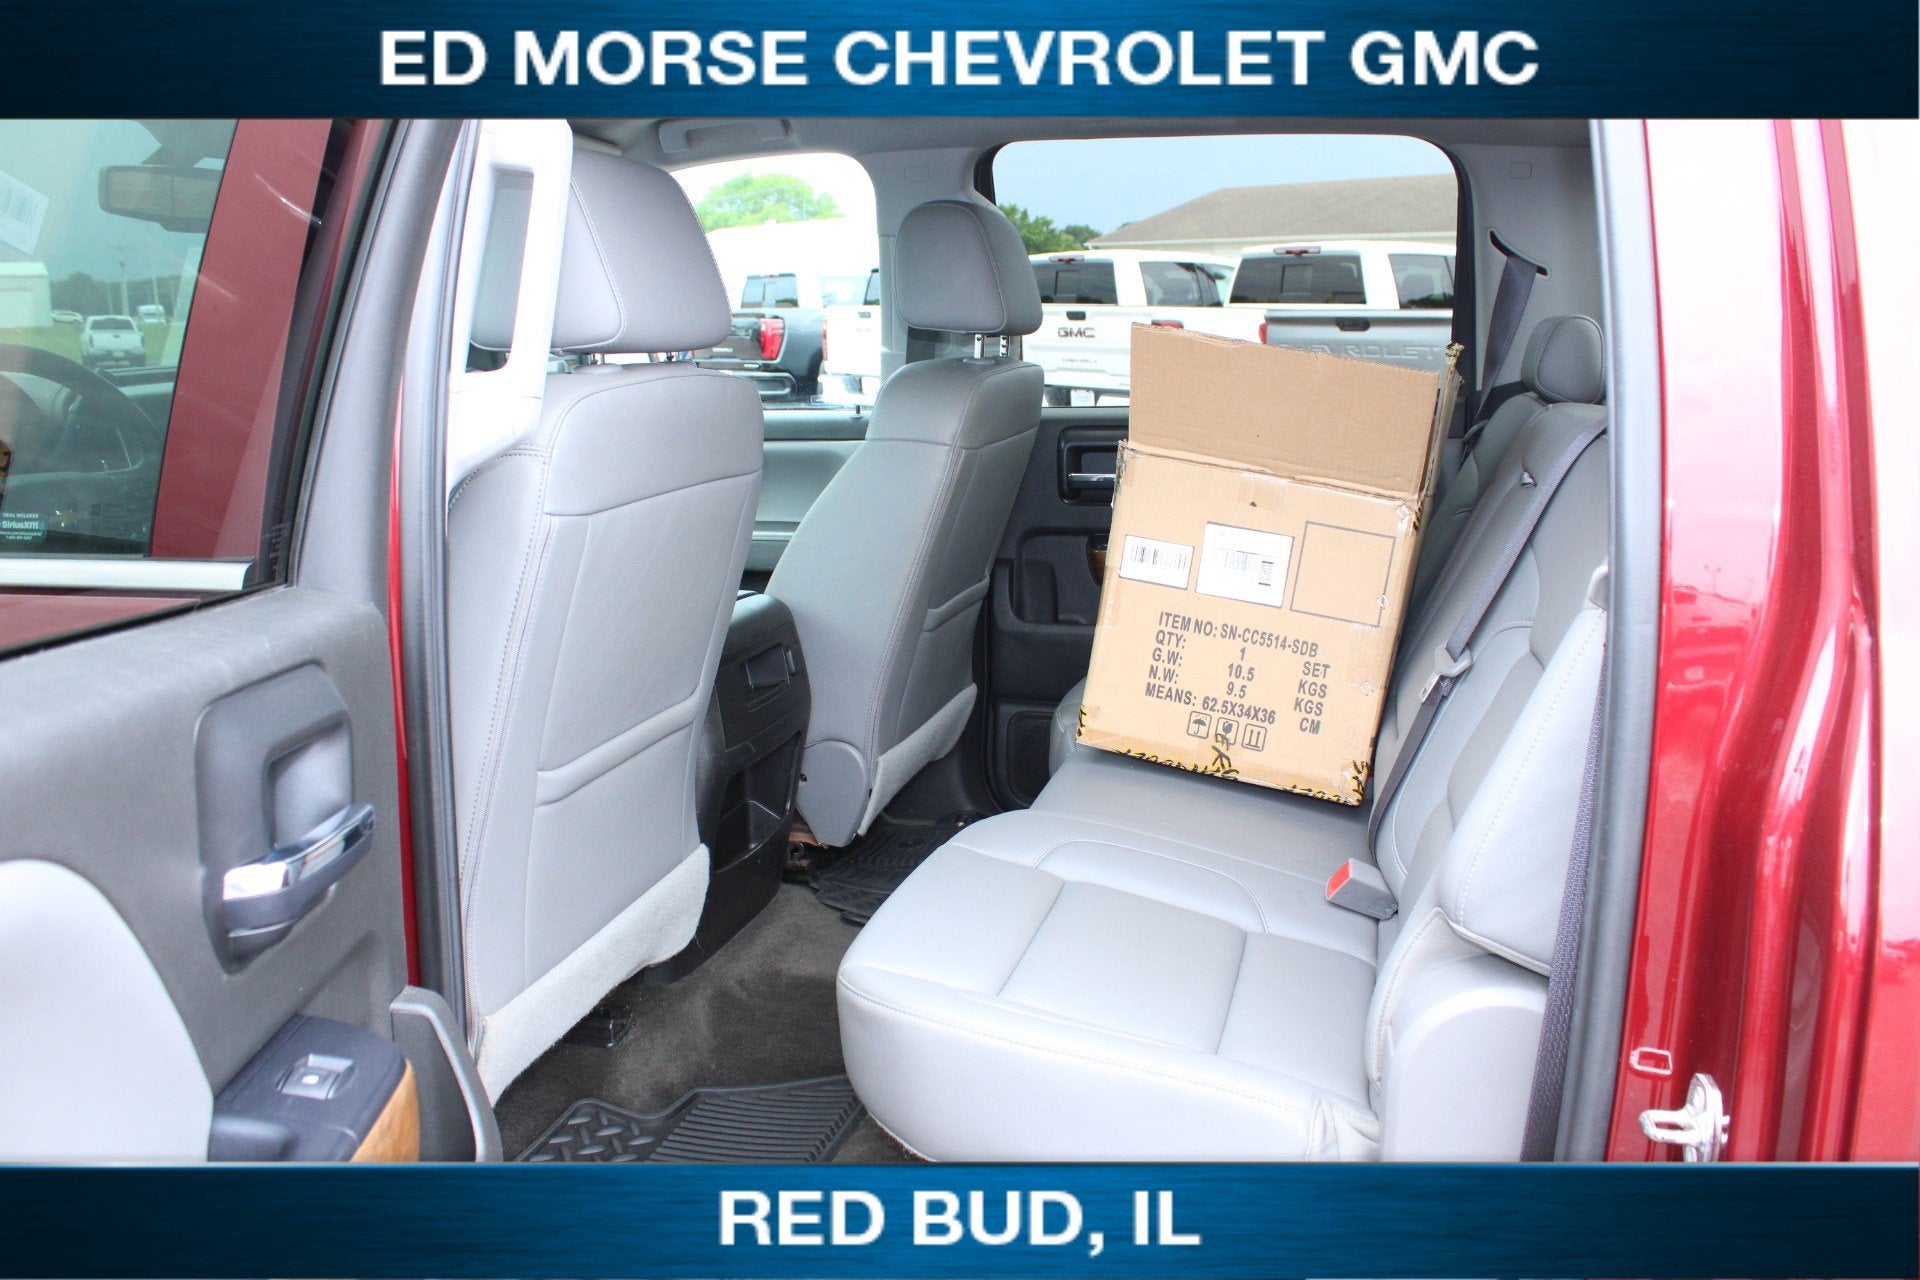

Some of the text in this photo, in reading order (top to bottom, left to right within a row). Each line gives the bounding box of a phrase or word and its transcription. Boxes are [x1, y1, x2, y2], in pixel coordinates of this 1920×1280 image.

[1057, 326, 1095, 338] GMC
[1155, 629, 1331, 680] QTY: 1 SET
[1158, 611, 1319, 658] ITEM NO: SN-CC5514-SDB
[1148, 664, 1325, 717] N.W: 9.5 KGS
[1152, 647, 1328, 700] G.W: 10.5 KGS
[1145, 682, 1321, 735] MEANS: 62.5X34X36 CM
